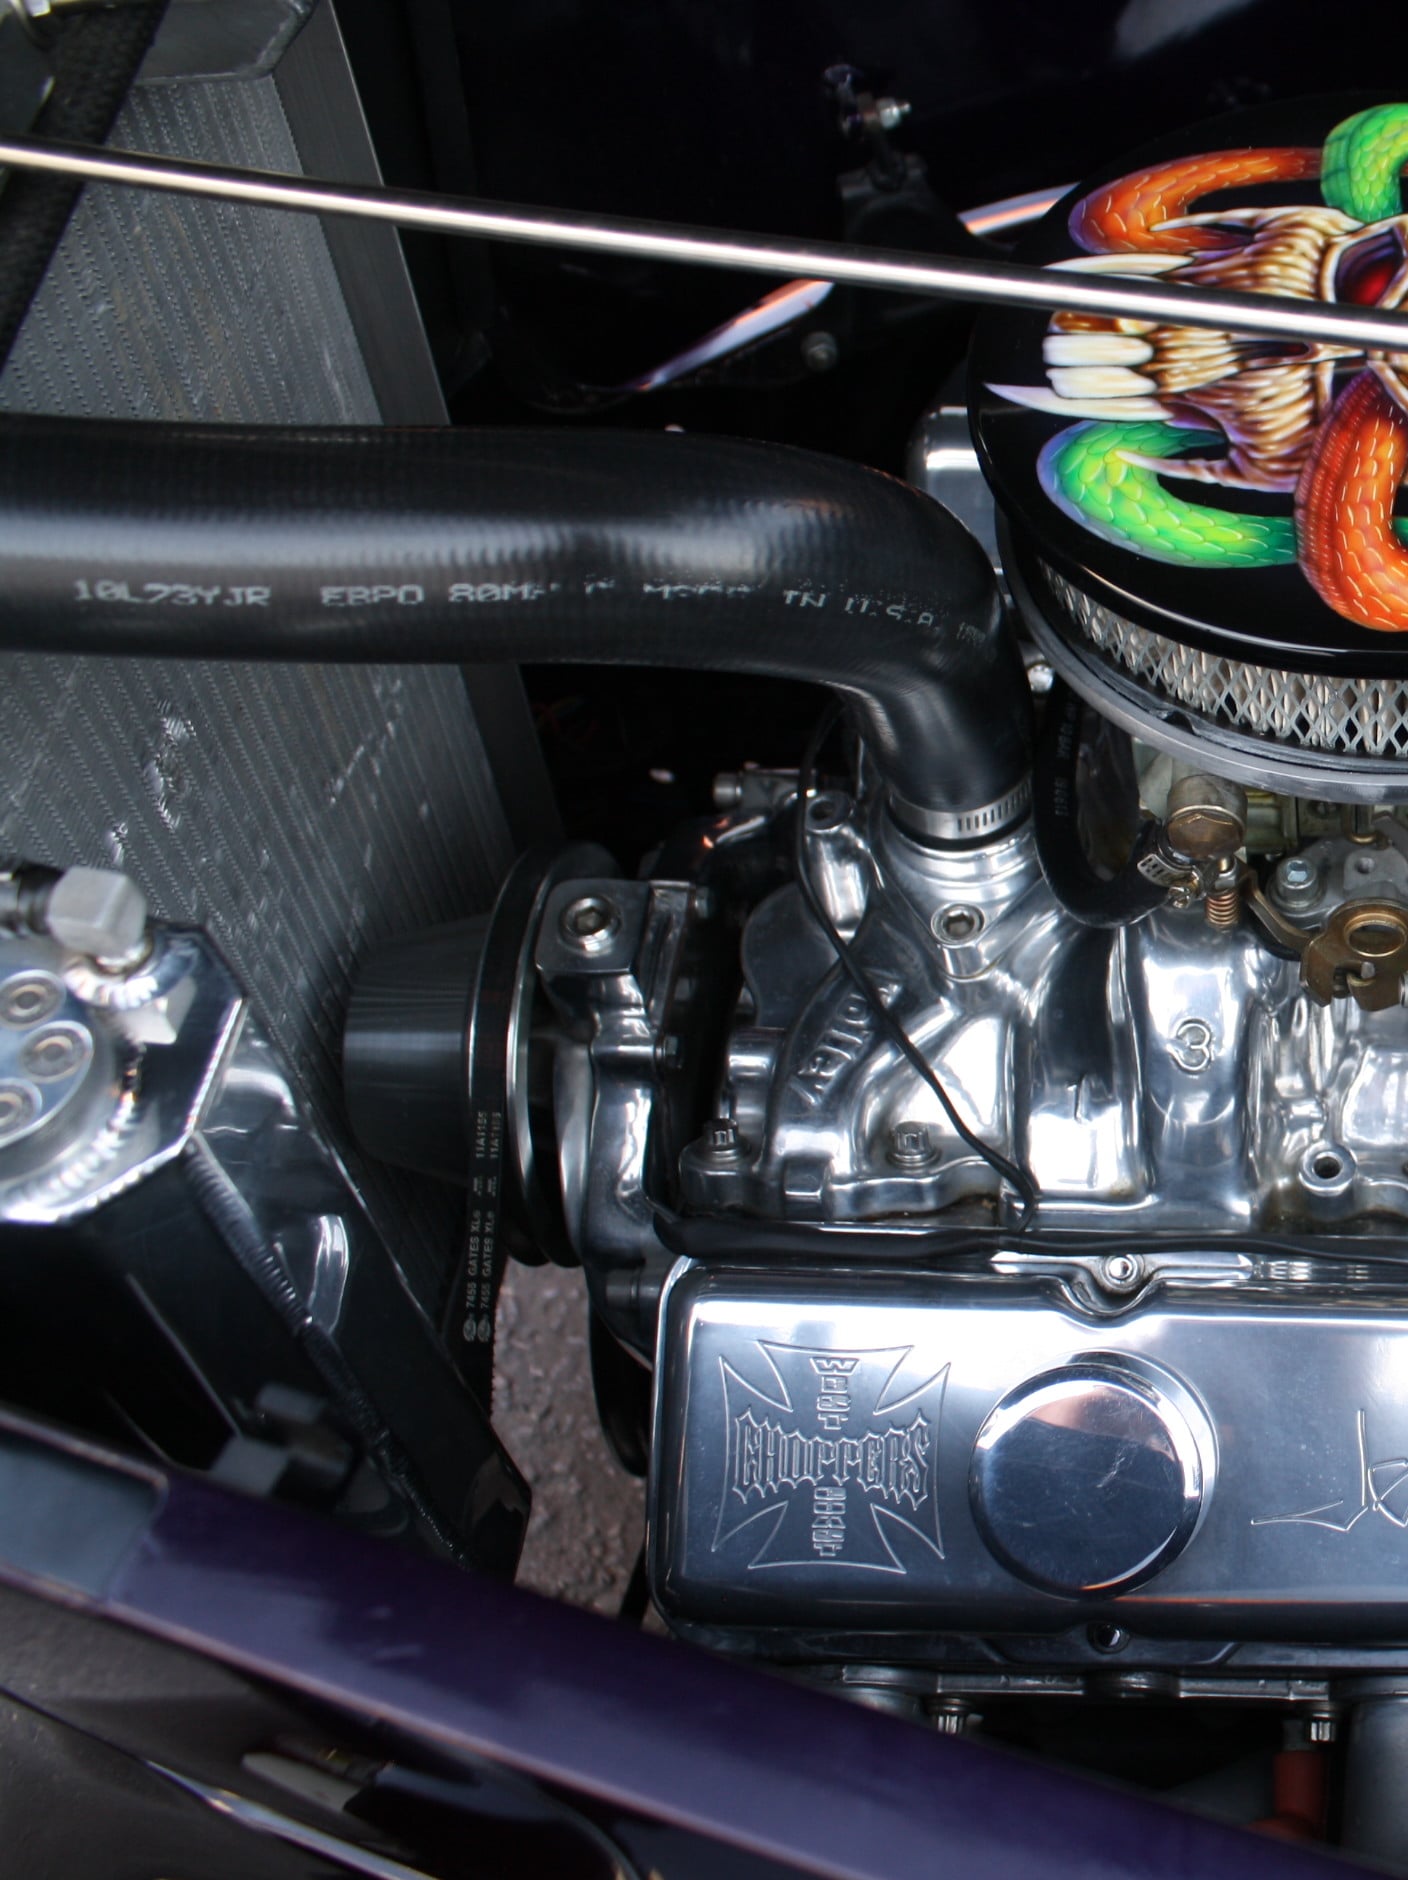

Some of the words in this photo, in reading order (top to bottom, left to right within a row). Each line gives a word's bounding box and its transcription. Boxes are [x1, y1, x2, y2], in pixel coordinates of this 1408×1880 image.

[1164, 1016, 1215, 1078] 3
[468, 1236, 480, 1277] GATES
[482, 1236, 494, 1277] GATES
[731, 1406, 931, 1511] CHOPPERS
